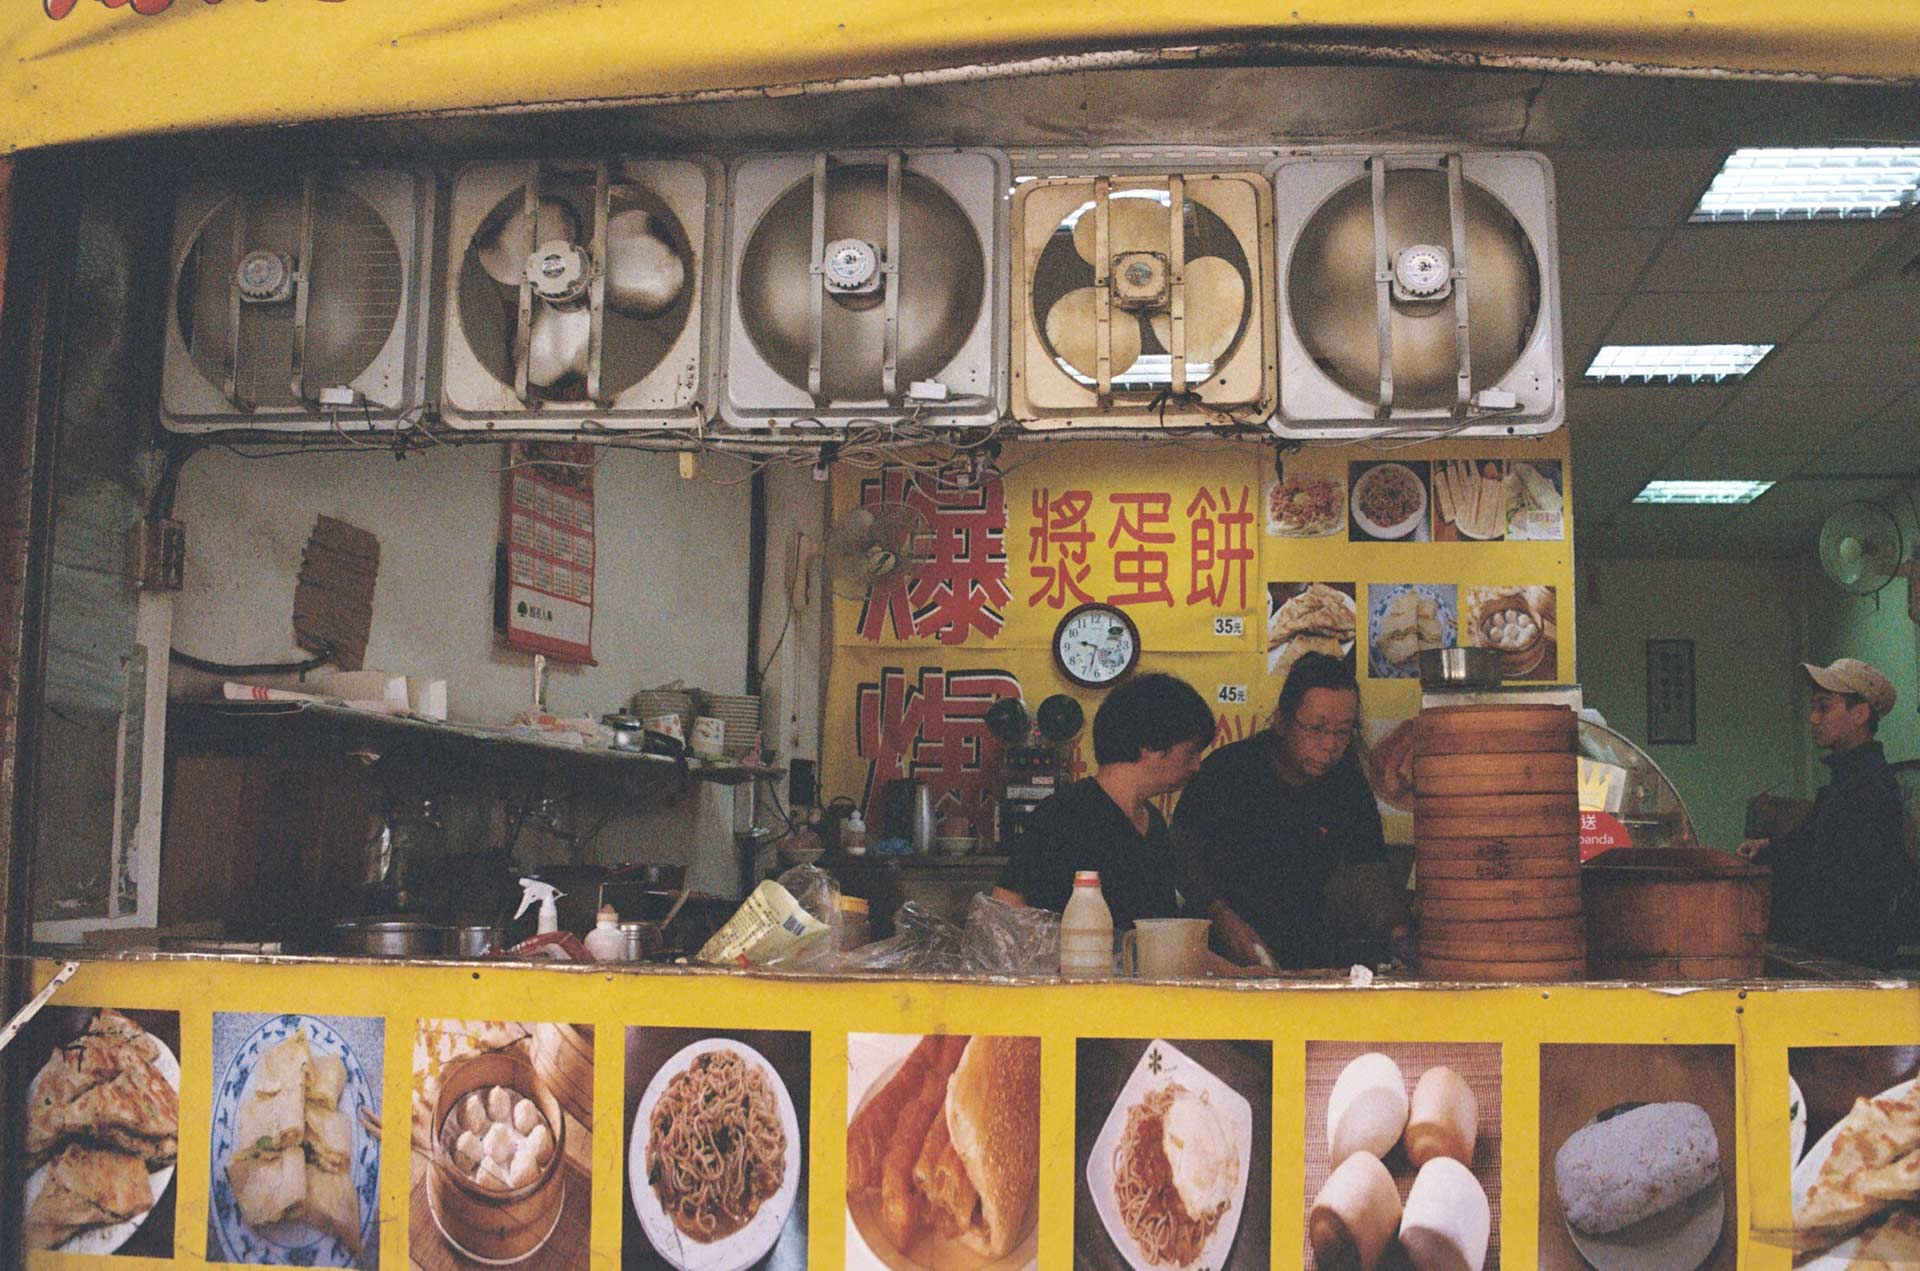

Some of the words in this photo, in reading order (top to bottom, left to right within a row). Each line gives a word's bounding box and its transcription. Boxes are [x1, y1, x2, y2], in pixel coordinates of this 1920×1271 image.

[1078, 618, 1086, 629] 11
[1090, 614, 1101, 624] 12
[1215, 618, 1242, 634] 35元
[1069, 629, 1079, 638] 10
[1064, 642, 1071, 652] 9
[1069, 656, 1076, 665] 8
[1081, 666, 1087, 675] 7
[1094, 668, 1101, 678] 6
[1219, 686, 1245, 702] 45元
